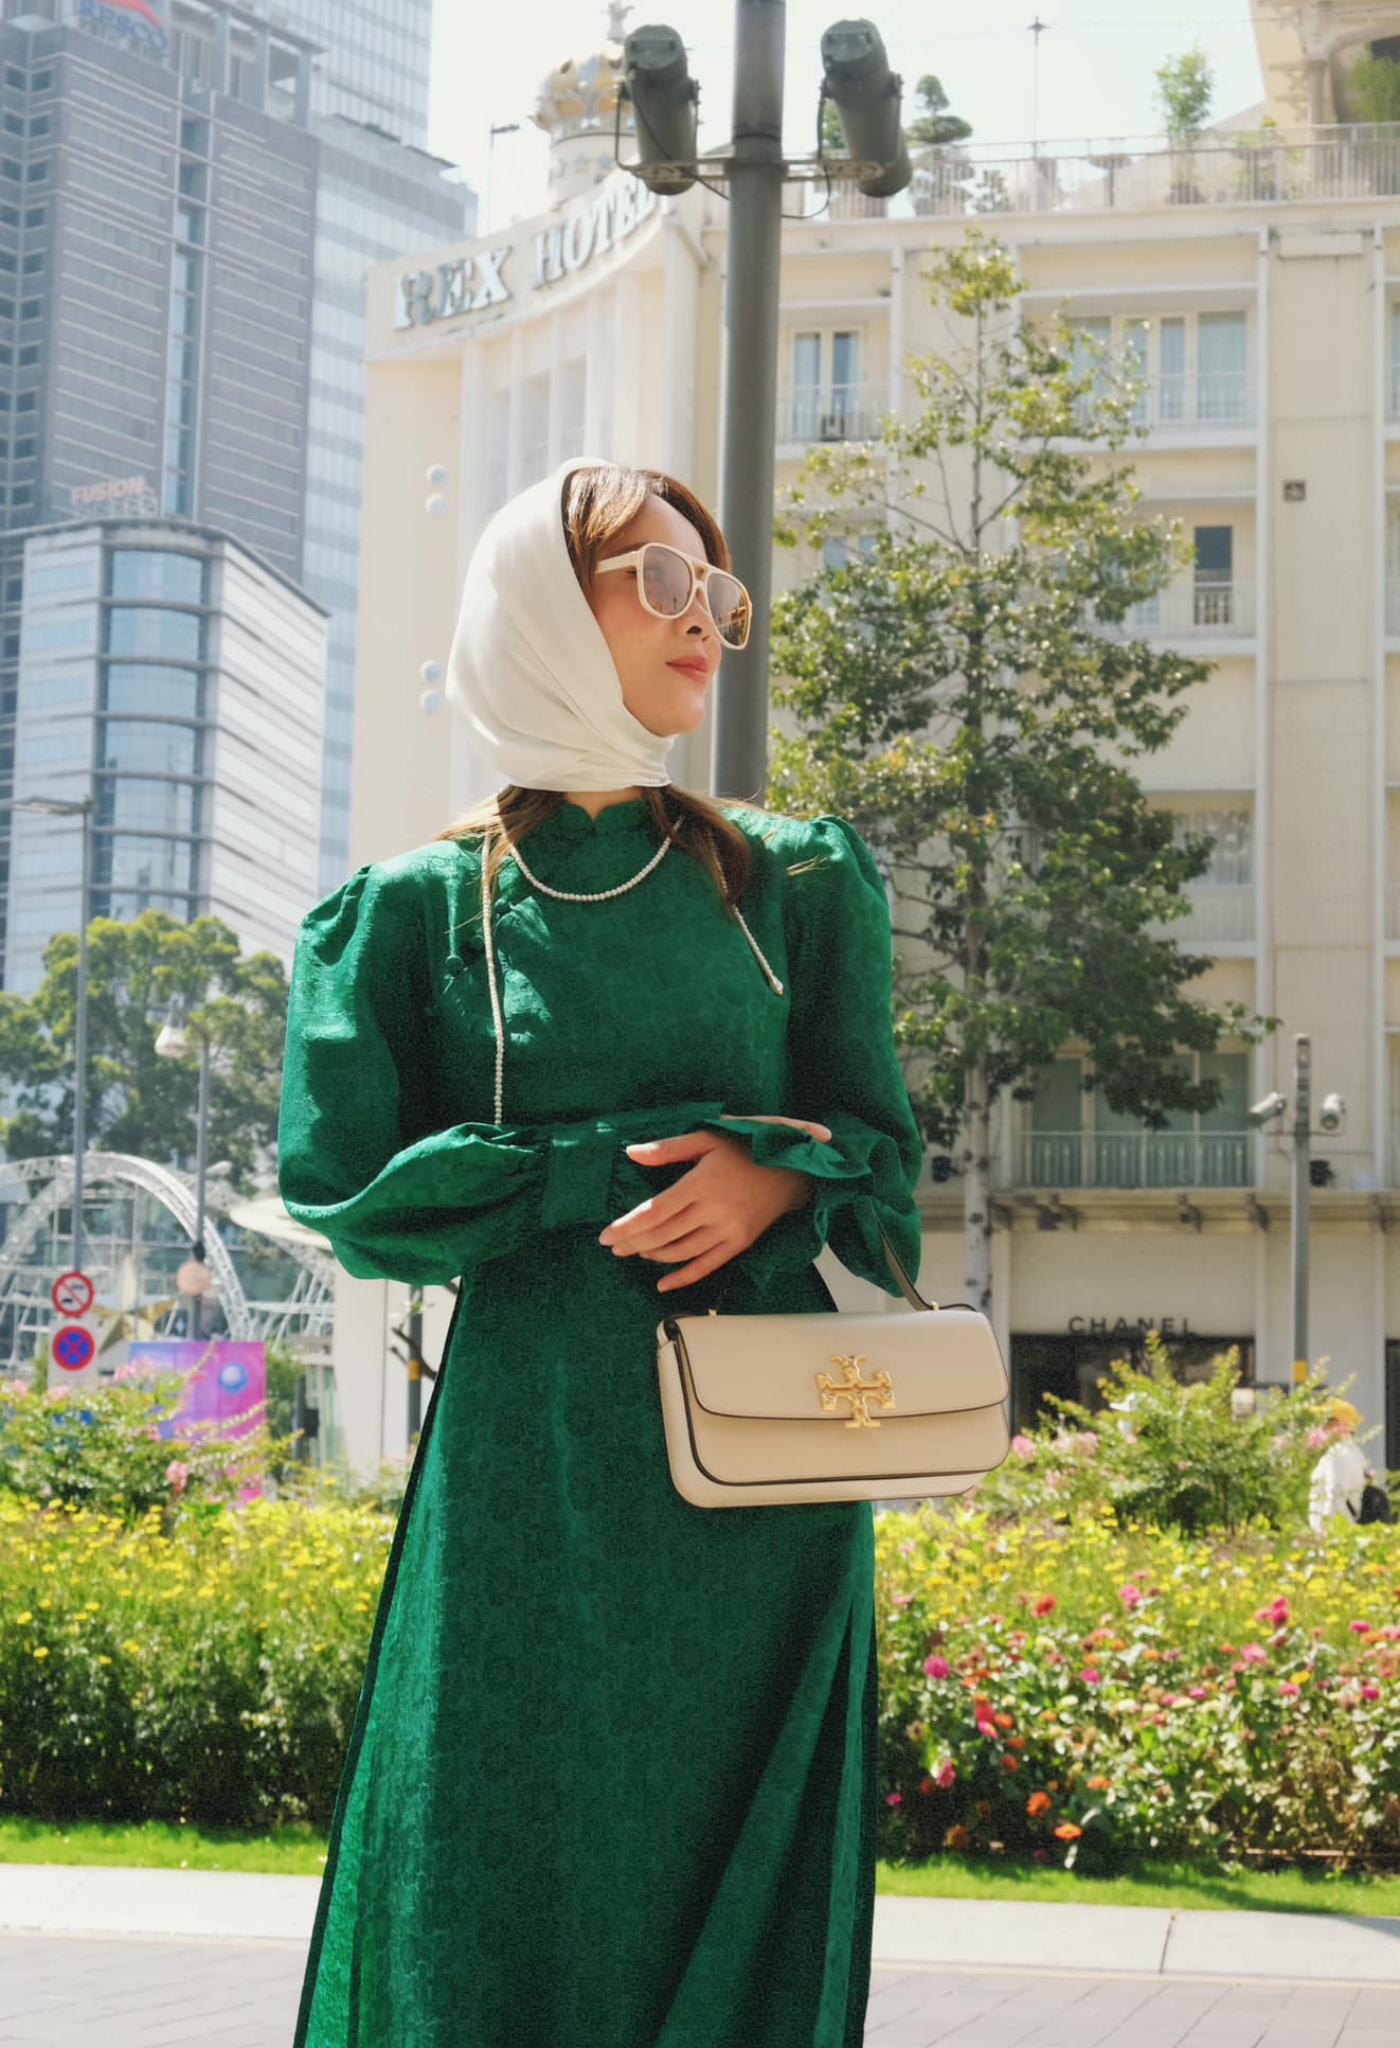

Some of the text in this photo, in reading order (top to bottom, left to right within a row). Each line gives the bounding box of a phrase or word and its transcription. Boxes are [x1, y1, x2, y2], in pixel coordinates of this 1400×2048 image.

[393, 174, 657, 330] REX HOTEL
[71, 476, 146, 507] FUSION
[1068, 1316, 1197, 1335] CHANEL
